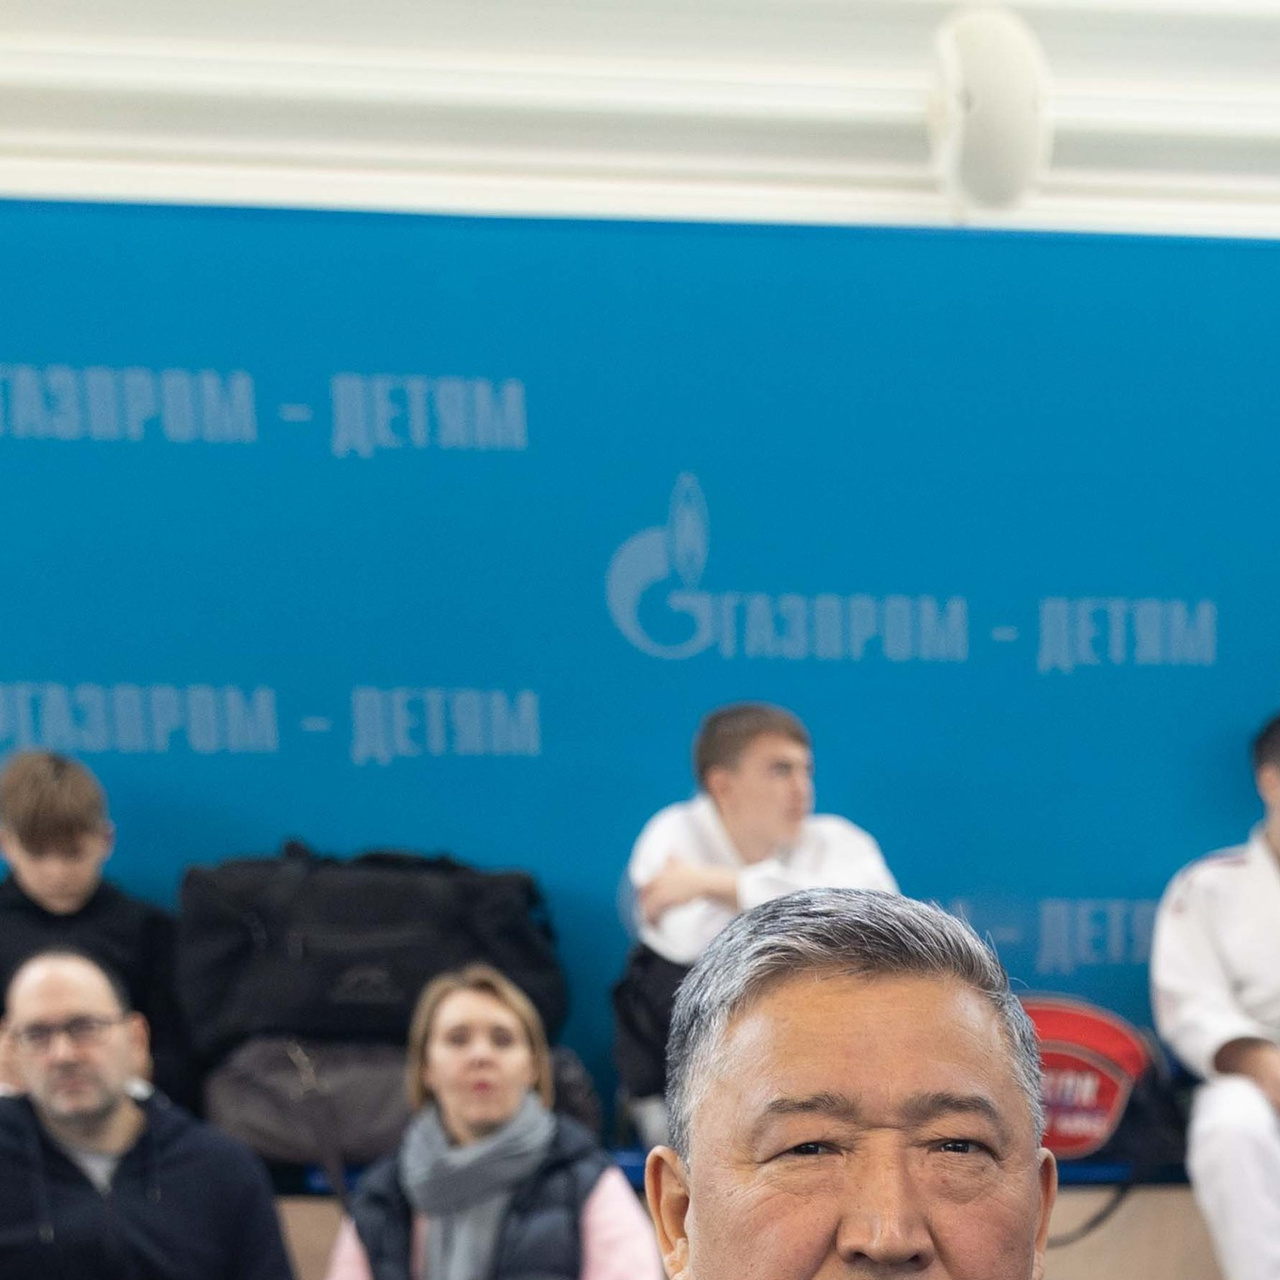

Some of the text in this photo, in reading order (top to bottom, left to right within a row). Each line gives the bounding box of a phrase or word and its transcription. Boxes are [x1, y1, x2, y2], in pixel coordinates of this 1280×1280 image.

[331, 373, 528, 458] ДЕТЯМ
[717, 593, 968, 662] ГАЗПРОМ
[1037, 597, 1218, 673] ДЕТЯМ
[351, 687, 541, 765] ДЕТЯМ
